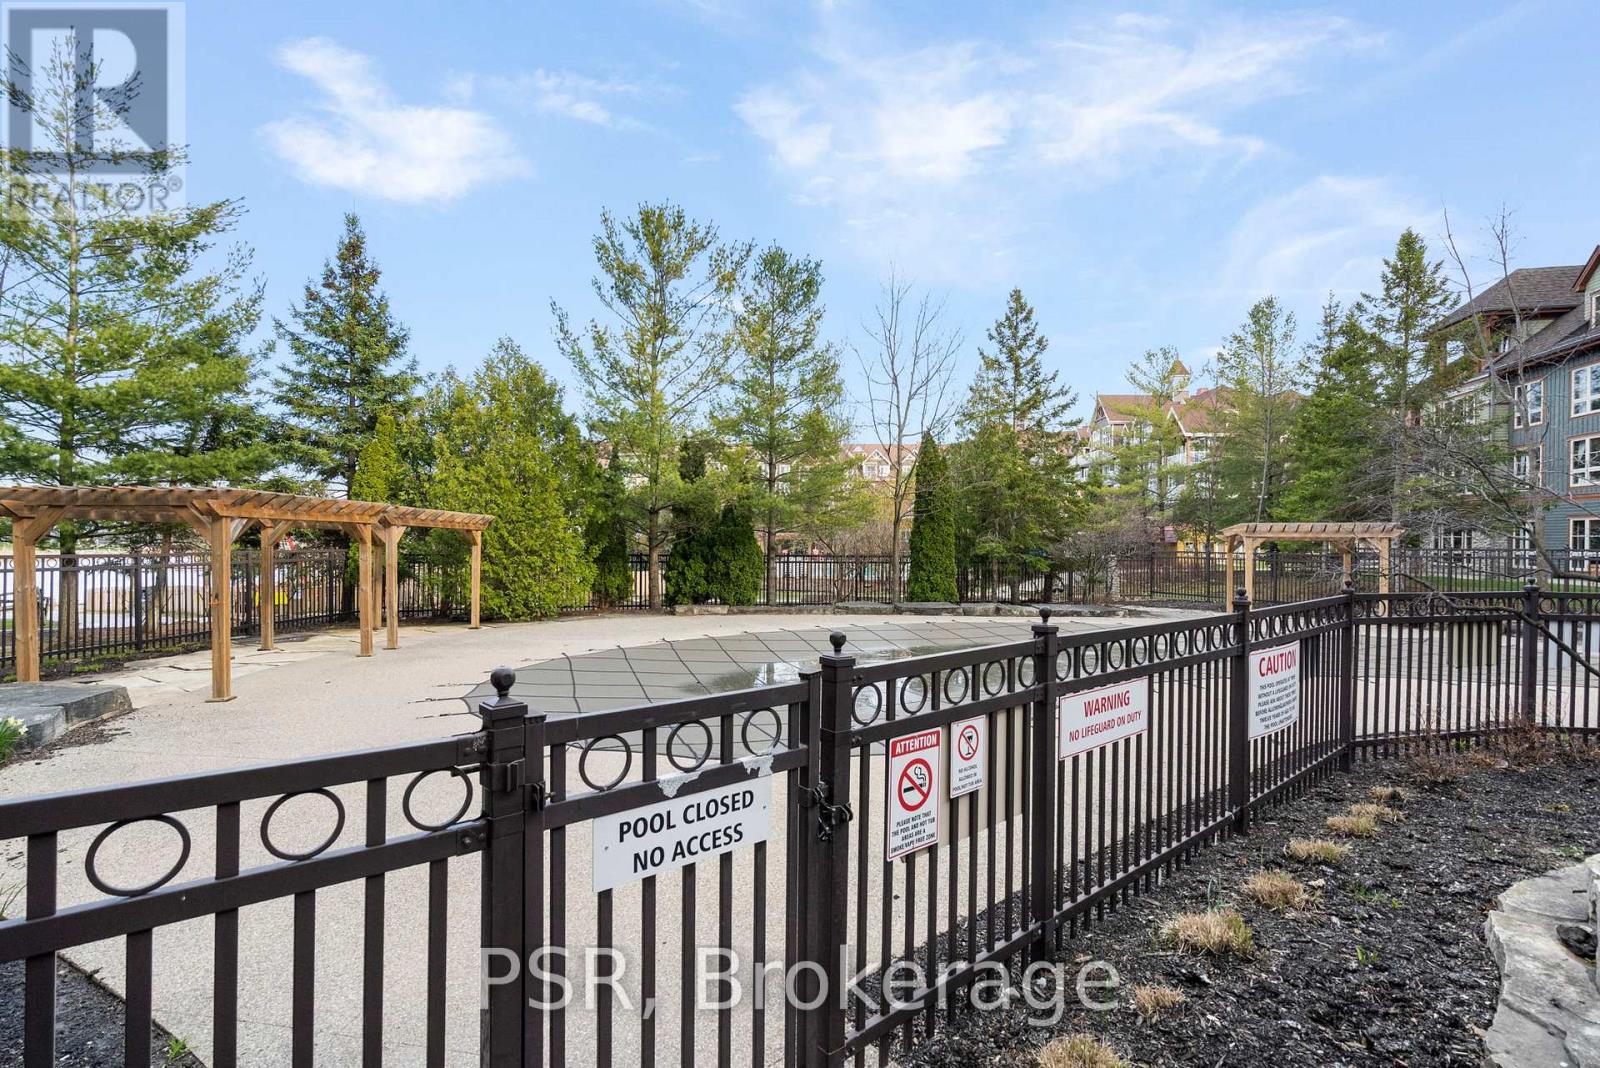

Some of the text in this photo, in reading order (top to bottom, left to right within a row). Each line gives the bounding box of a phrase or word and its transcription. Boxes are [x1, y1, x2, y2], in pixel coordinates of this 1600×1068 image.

[1260, 649, 1296, 677] CAUTION
[1084, 691, 1130, 717] WARNING
[1069, 710, 1142, 742] NO LIFEGUARD ON DUTY
[895, 734, 937, 755] ATTENTION
[619, 790, 754, 843] POOL CLOSED
[896, 817, 910, 827] PLEASE
[911, 814, 921, 822] NOTE
[900, 826, 910, 835] POOL
[911, 822, 919, 830] AND
[633, 822, 743, 873] NO ACCESS
[915, 835, 925, 844] FREE
[925, 832, 935, 841] ZONE
